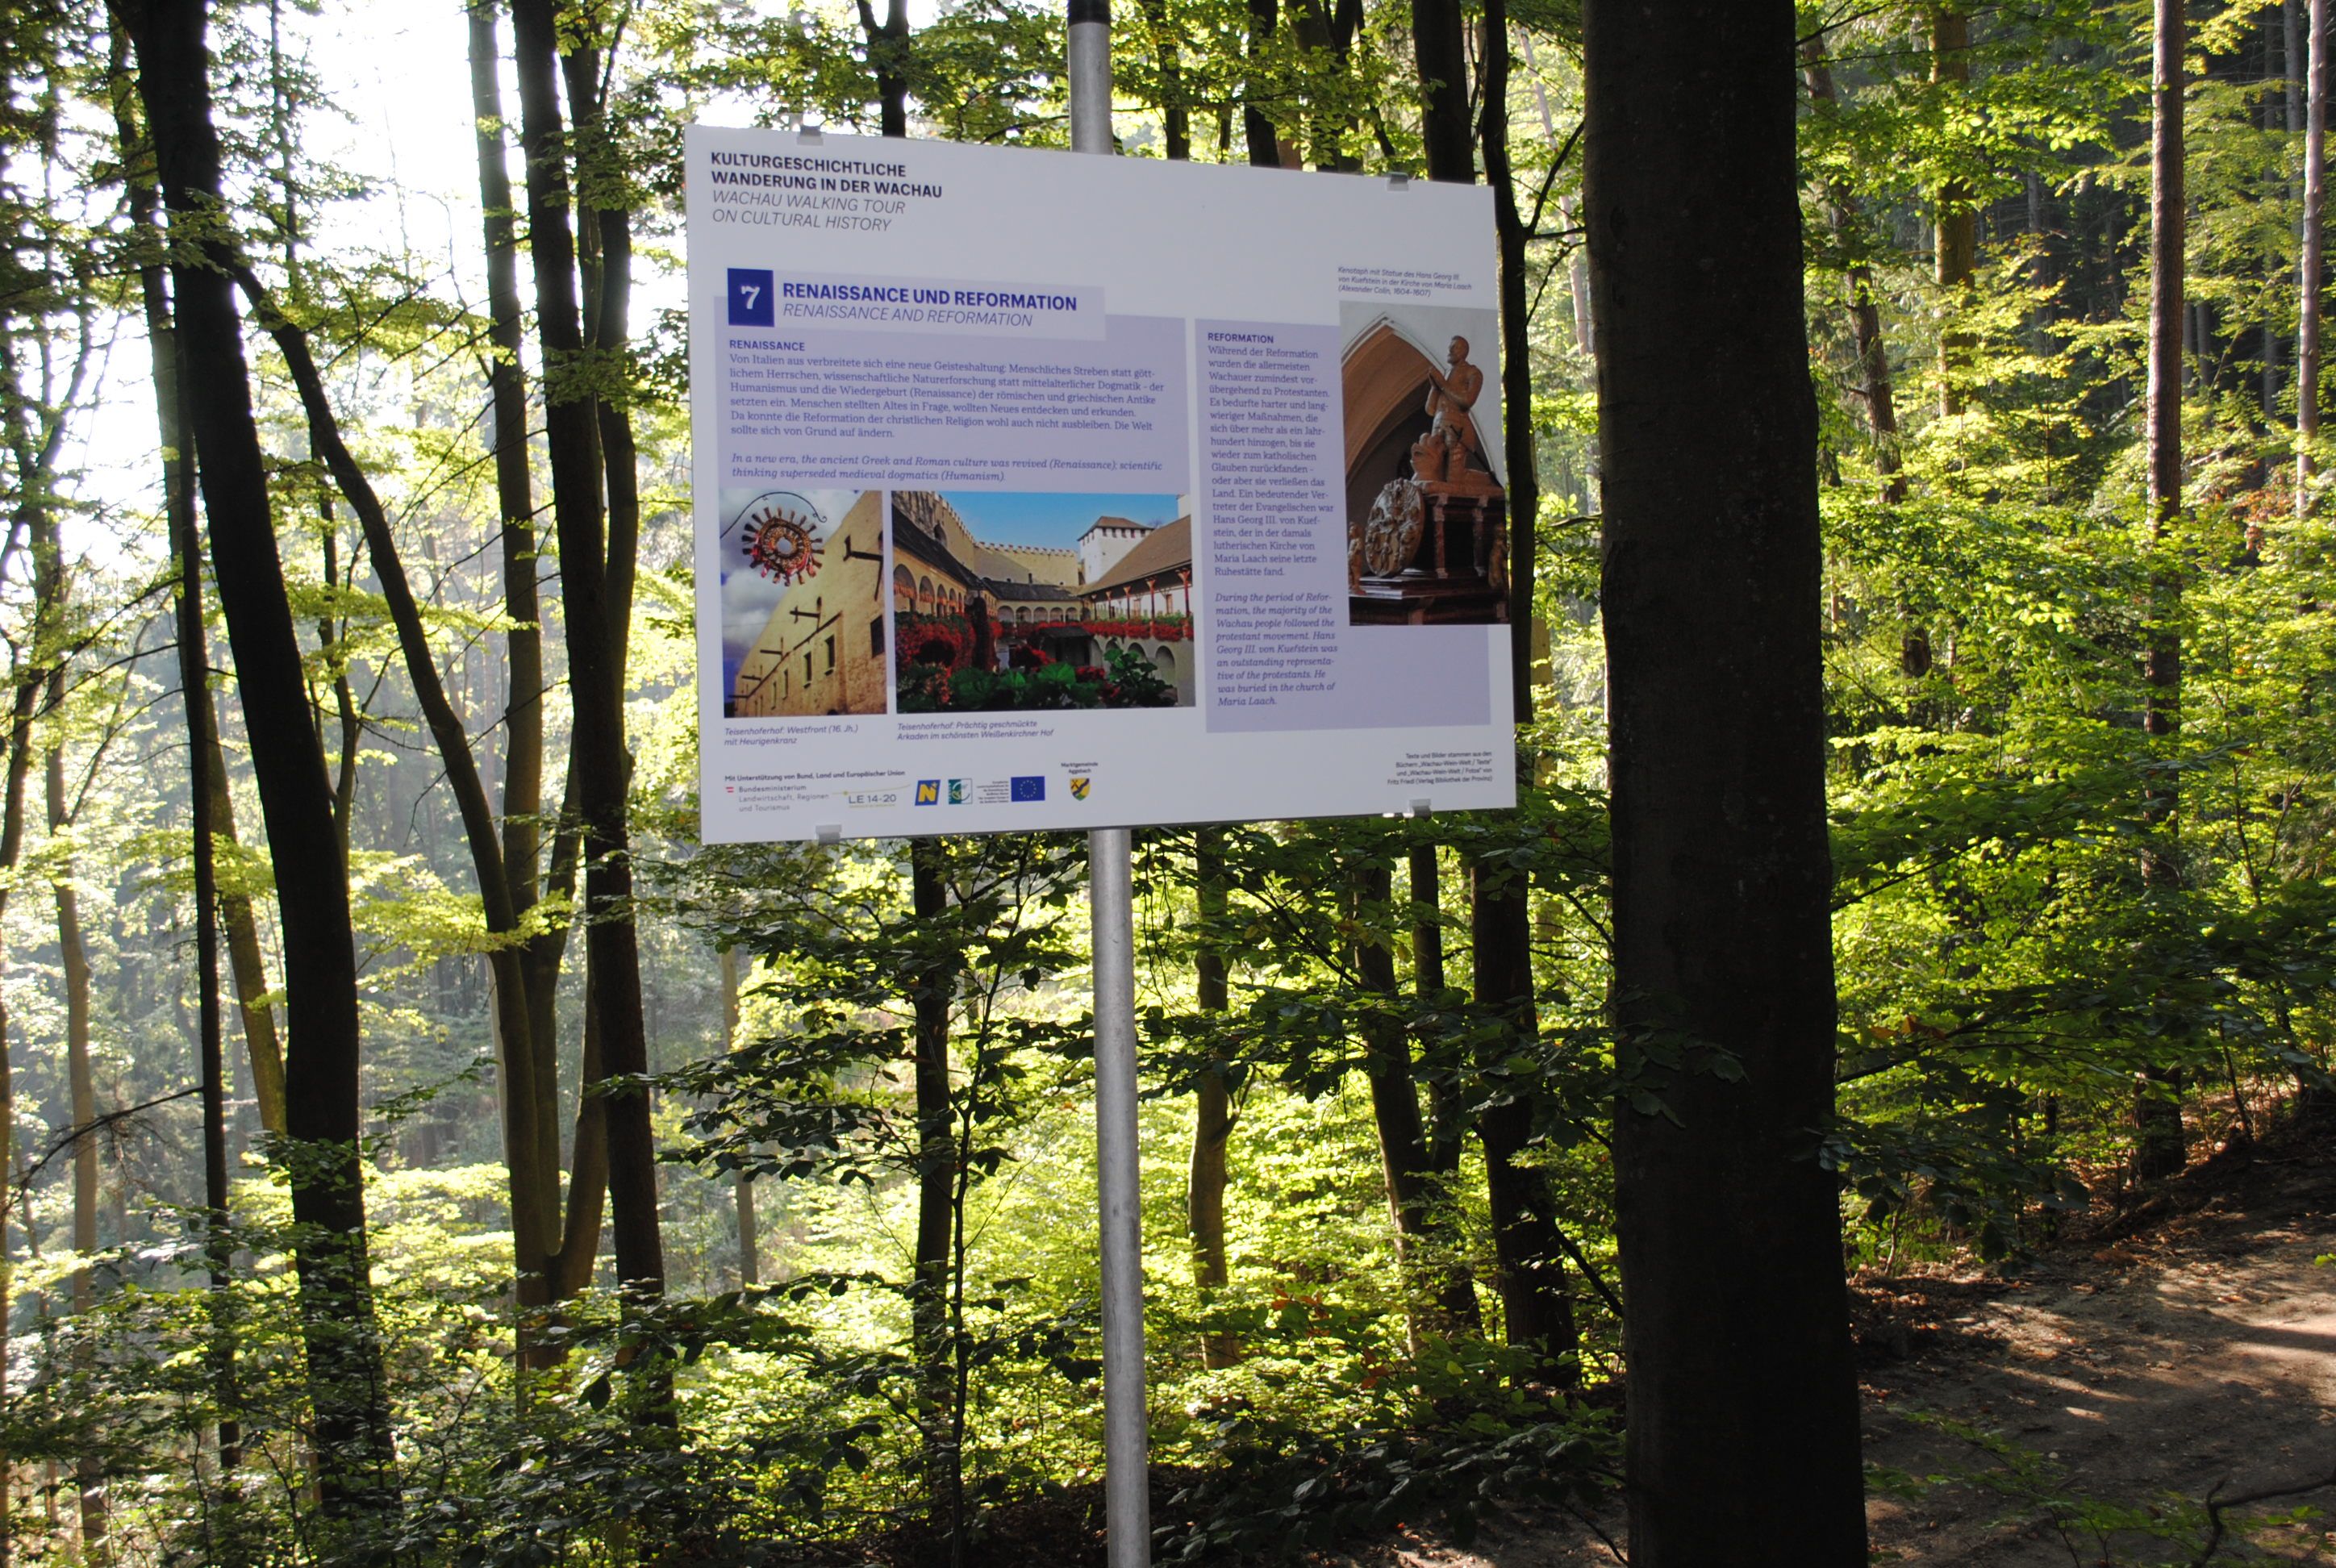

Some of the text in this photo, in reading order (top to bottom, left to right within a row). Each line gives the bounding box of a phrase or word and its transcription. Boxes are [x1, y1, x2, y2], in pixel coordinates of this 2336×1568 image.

[711, 152, 905, 177] KULTURGESCHICHTLICHE
[711, 170, 941, 198] WANDERUNG IN DER WACHAU
[713, 190, 905, 214] WACHAU WALKING TOUR
[712, 208, 891, 231] ON CULTURAL HISTORY
[740, 286, 761, 310] 7
[782, 282, 1076, 311] RENAISSANCE UND REFORMATION
[782, 302, 1032, 327] RENAISSANCE AND REFORMATION
[1208, 332, 1274, 343] REFORMATION
[729, 339, 804, 351] RENAISSANCE
[1207, 344, 1318, 358] Während der Reformation
[729, 353, 749, 363] Von
[752, 353, 785, 365] Italien
[786, 357, 804, 365] aus
[806, 357, 861, 367] verbreitete
[863, 358, 882, 368] sich
[885, 359, 906, 369] eine
[907, 361, 932, 369] neue
[1008, 363, 1071, 374] Menschliches
[1073, 365, 1108, 376] Streben
[1111, 369, 1131, 377] statt
[1133, 369, 1154, 379] gött-
[1208, 358, 1310, 371] wurden die allermeisten
[729, 367, 763, 377] lichem
[765, 369, 821, 380] Herrschen,
[823, 371, 910, 382] wissenschaftliche
[911, 373, 996, 387] Naturerforschung
[998, 377, 1019, 386] statt
[1022, 377, 1095, 389] mittelalterlicher
[1098, 380, 1141, 391] Dogmatik
[1149, 382, 1164, 391] der
[1208, 371, 1252, 382] Wachauer
[1254, 373, 1298, 383] zumindest
[730, 382, 1155, 404] Humanismus und die Wiedergeburt (Renaissance) der römischen und griechischen Antike
[1208, 384, 1259, 395] übergehend
[1274, 386, 1329, 397] Protestanten.
[729, 397, 767, 407] setzten
[790, 398, 842, 408] Menschen
[844, 399, 880, 410] stellten
[882, 400, 907, 410] Altes
[910, 401, 920, 411] in
[921, 401, 950, 413] Frage,
[952, 402, 987, 412] wollten
[990, 403, 1019, 413] Neues
[1020, 405, 1069, 415] entdecken
[1070, 406, 1089, 415] und
[1091, 407, 1136, 416] erkunden.
[1209, 397, 1328, 411] Es bedurfte harter und lang-
[731, 410, 1152, 430] Da konnte die Reformation der christlichen Religion wohl auch nicht ausbleiben. Die Welt
[730, 424, 894, 437] sollte sich von Grund auf ändern.
[731, 452, 742, 462] In
[754, 455, 777, 463] new
[778, 456, 799, 464] era,
[801, 454, 817, 463] the
[819, 455, 858, 464] ancient
[861, 455, 890, 465] Greek
[892, 456, 912, 465] and
[915, 456, 950, 466] Roman
[953, 457, 988, 466] culture
[1012, 459, 1047, 468] revived
[1119, 461, 1162, 470] scientific
[732, 467, 778, 479] thinking
[780, 469, 836, 479] superseded
[838, 469, 885, 478] medieval
[887, 469, 938, 481] dogmatics
[786, 725, 827, 733] Westfront
[955, 721, 987, 730] Prächtig
[988, 719, 1037, 729] geschmückte
[980, 729, 1039, 738] Weißenkirchner
[1040, 728, 1053, 736] Hof
[739, 736, 797, 746] Heurigenkranz
[738, 785, 806, 793] Bundesministerium
[848, 794, 896, 804] LE 14-20
[738, 803, 790, 812] und Tourismus
